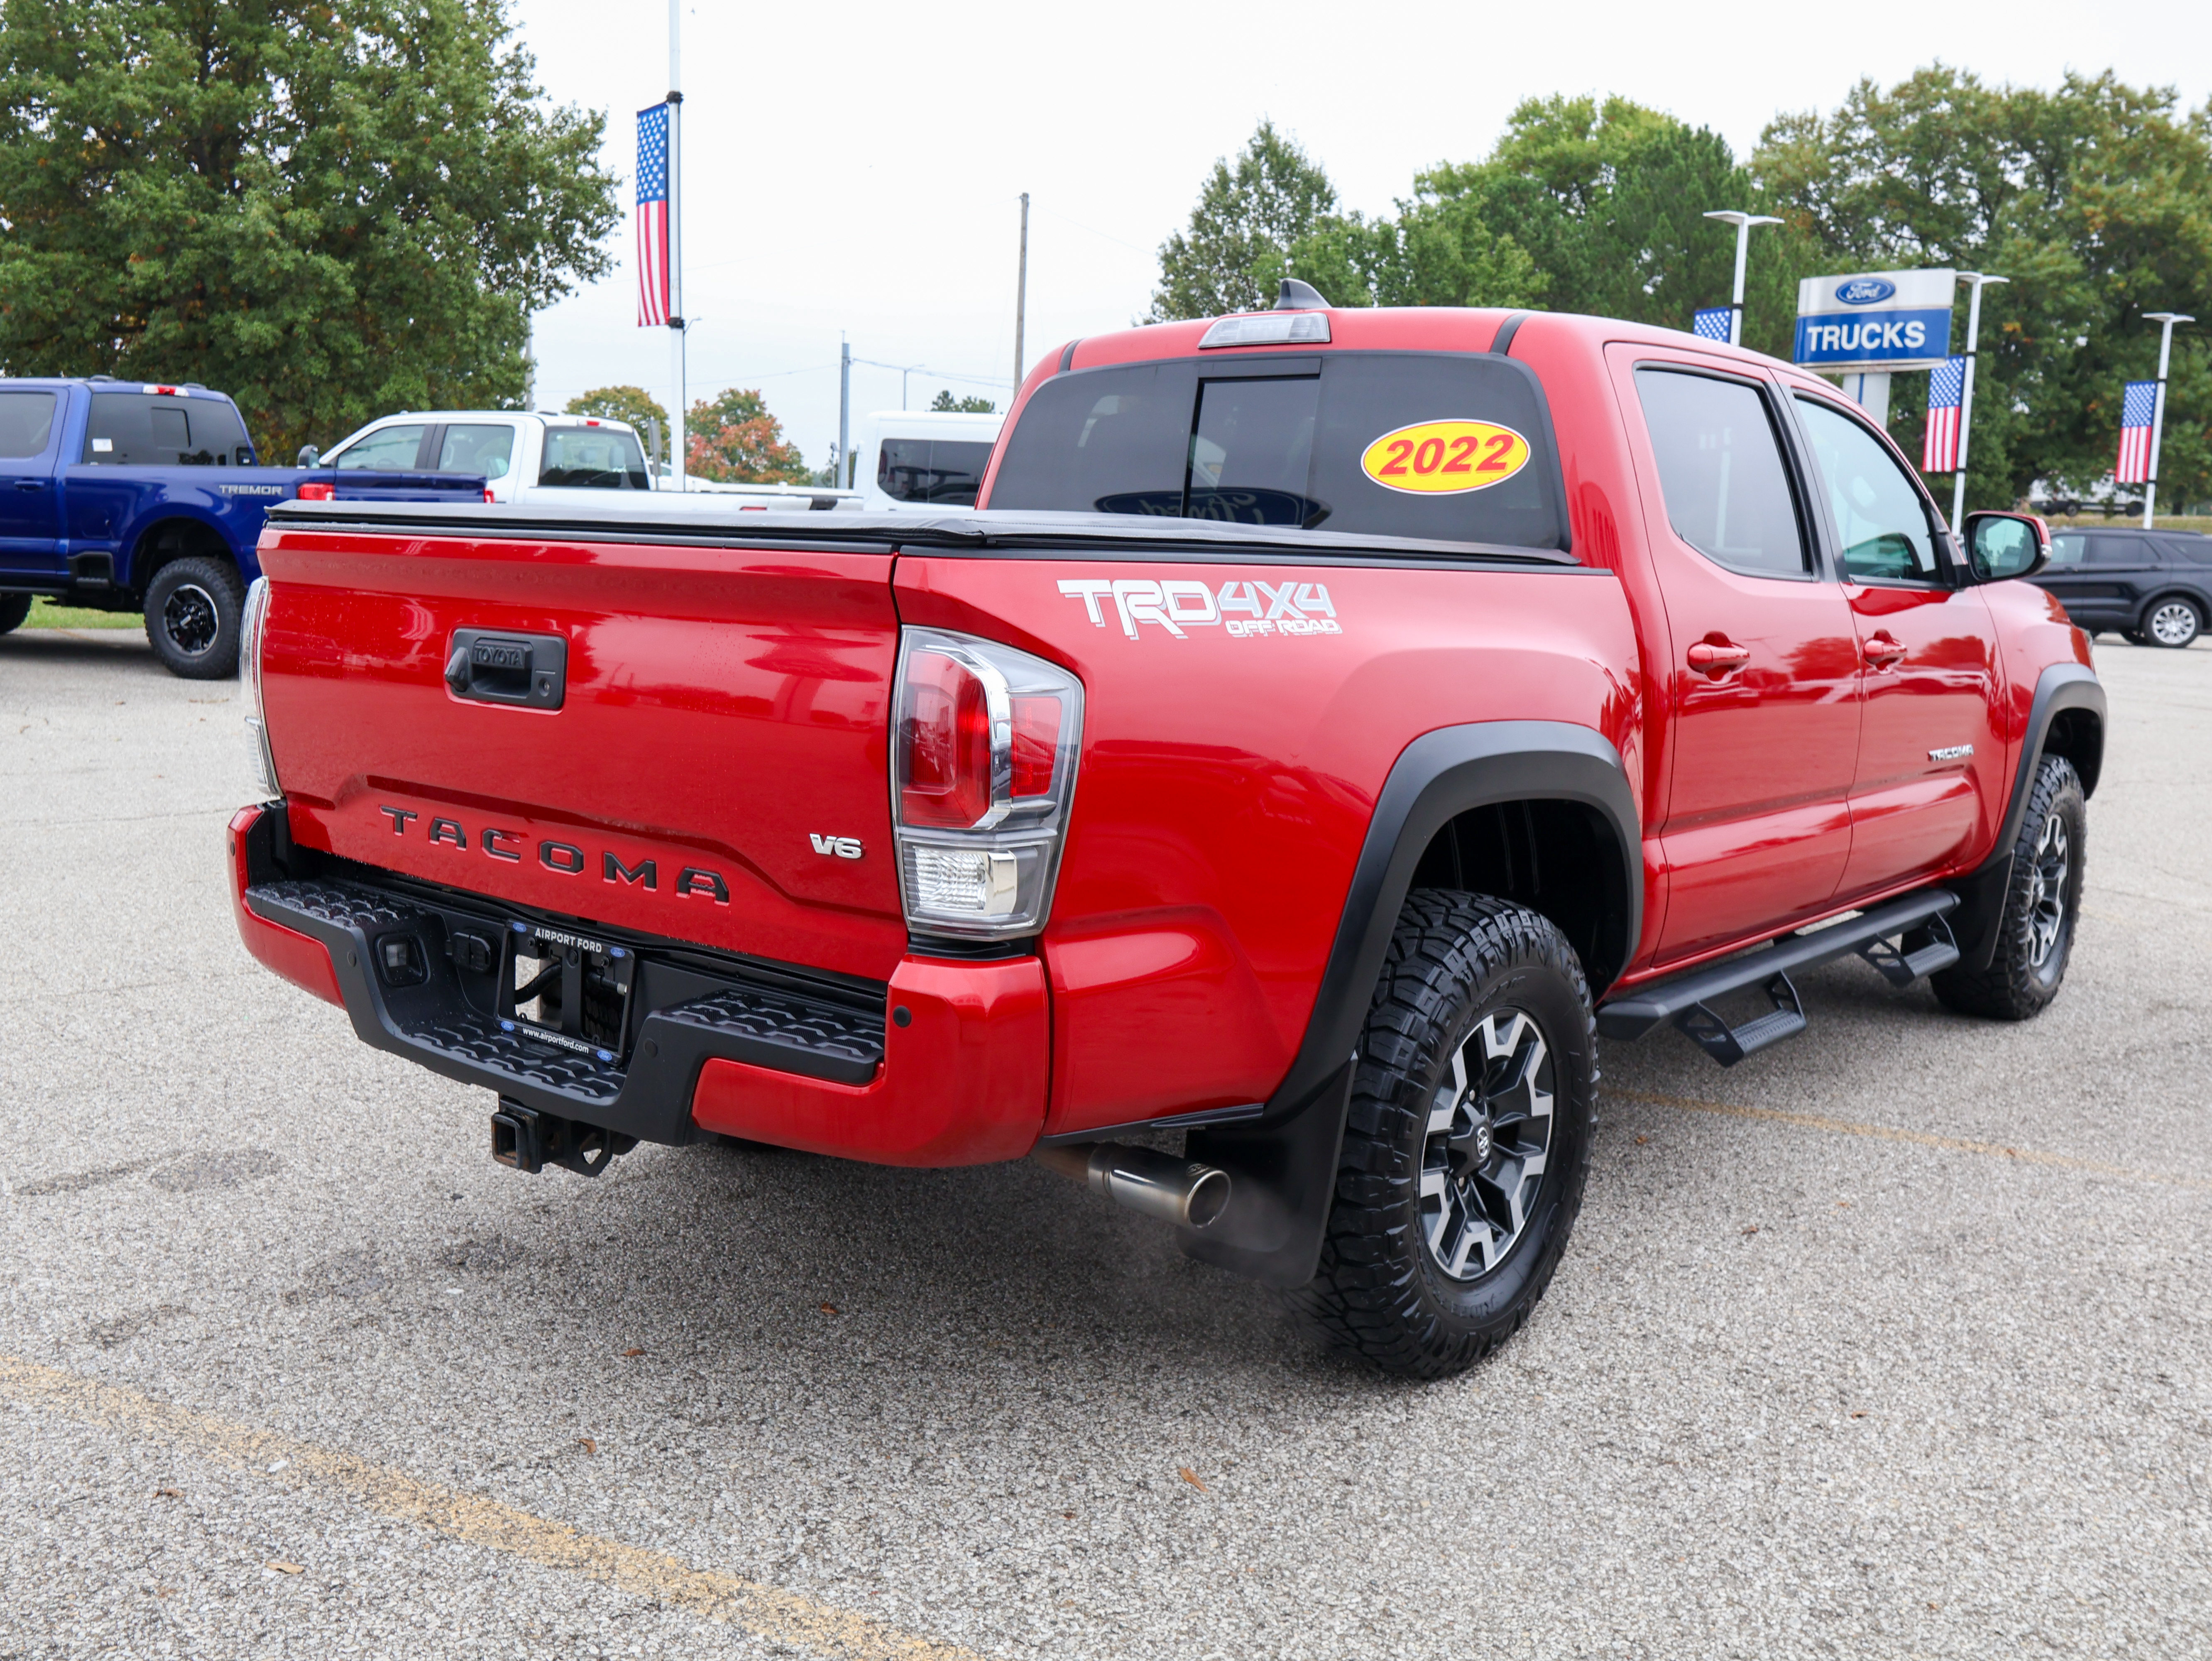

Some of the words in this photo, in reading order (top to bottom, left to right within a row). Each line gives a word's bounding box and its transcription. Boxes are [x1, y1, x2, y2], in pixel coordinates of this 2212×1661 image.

[1846, 282, 1881, 299] Ford
[1807, 320, 1926, 351] TRUCKS
[1378, 434, 1515, 478] 2022
[219, 484, 282, 495] TREMOR
[1057, 580, 1221, 640] TRD
[1275, 619, 1343, 636] ROAD
[474, 646, 523, 666] TOYOTA
[379, 805, 729, 906] TACOMA
[810, 833, 862, 859] V6
[535, 928, 575, 946] AIRPORT
[577, 938, 602, 953] FORD
[522, 1027, 589, 1054] www.airportford.com
